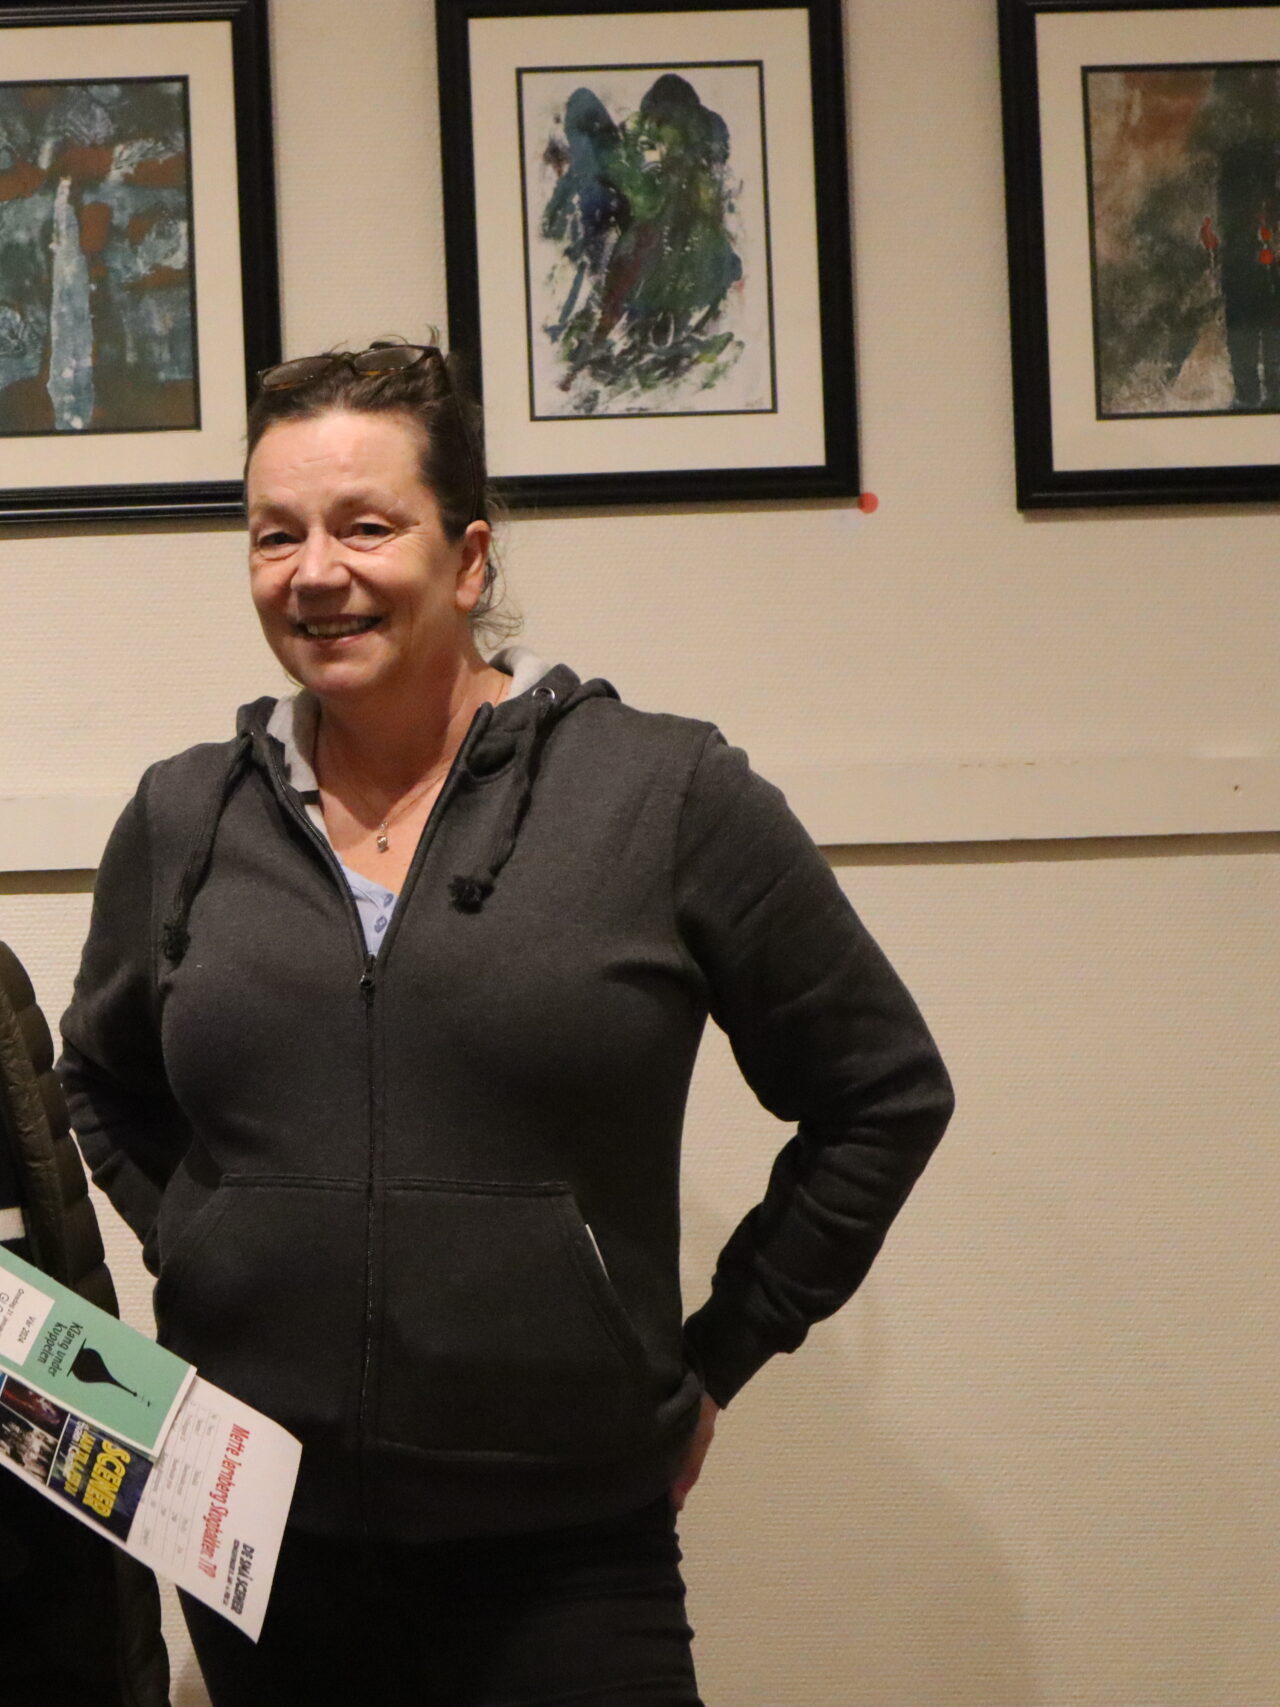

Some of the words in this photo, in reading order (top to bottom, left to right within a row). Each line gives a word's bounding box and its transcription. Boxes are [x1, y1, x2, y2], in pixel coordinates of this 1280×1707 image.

[37, 1321, 64, 1364] kuppelen
[58, 1321, 84, 1350] Klang
[48, 1349, 67, 1377] under
[225, 1423, 251, 1457] Mette
[82, 1439, 131, 1518] SCENER
[209, 1453, 242, 1505] Jernberg
[240, 1542, 255, 1560] DE
[230, 1576, 249, 1616] SCENER
